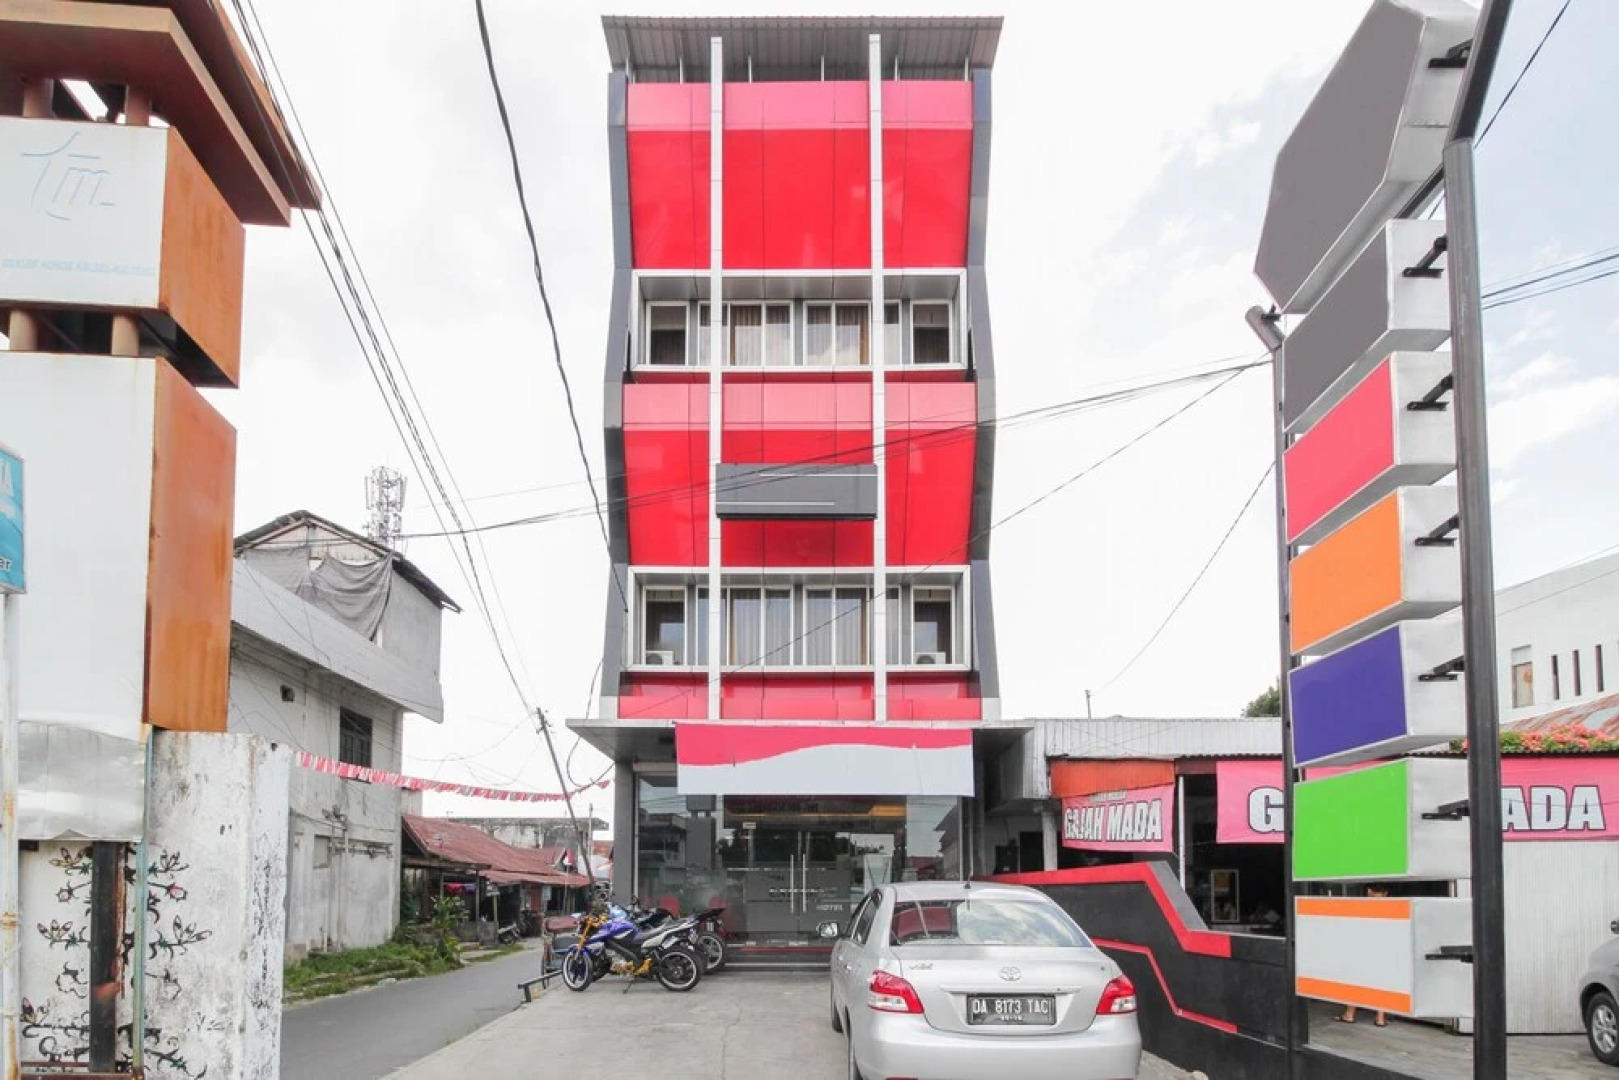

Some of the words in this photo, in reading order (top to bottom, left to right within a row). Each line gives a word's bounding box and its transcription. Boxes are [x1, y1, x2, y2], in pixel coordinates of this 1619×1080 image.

[1106, 798, 1163, 842] MADA
[1500, 785, 1607, 832] ADA
[972, 999, 987, 1014] DA
[995, 999, 1021, 1014] 8173
